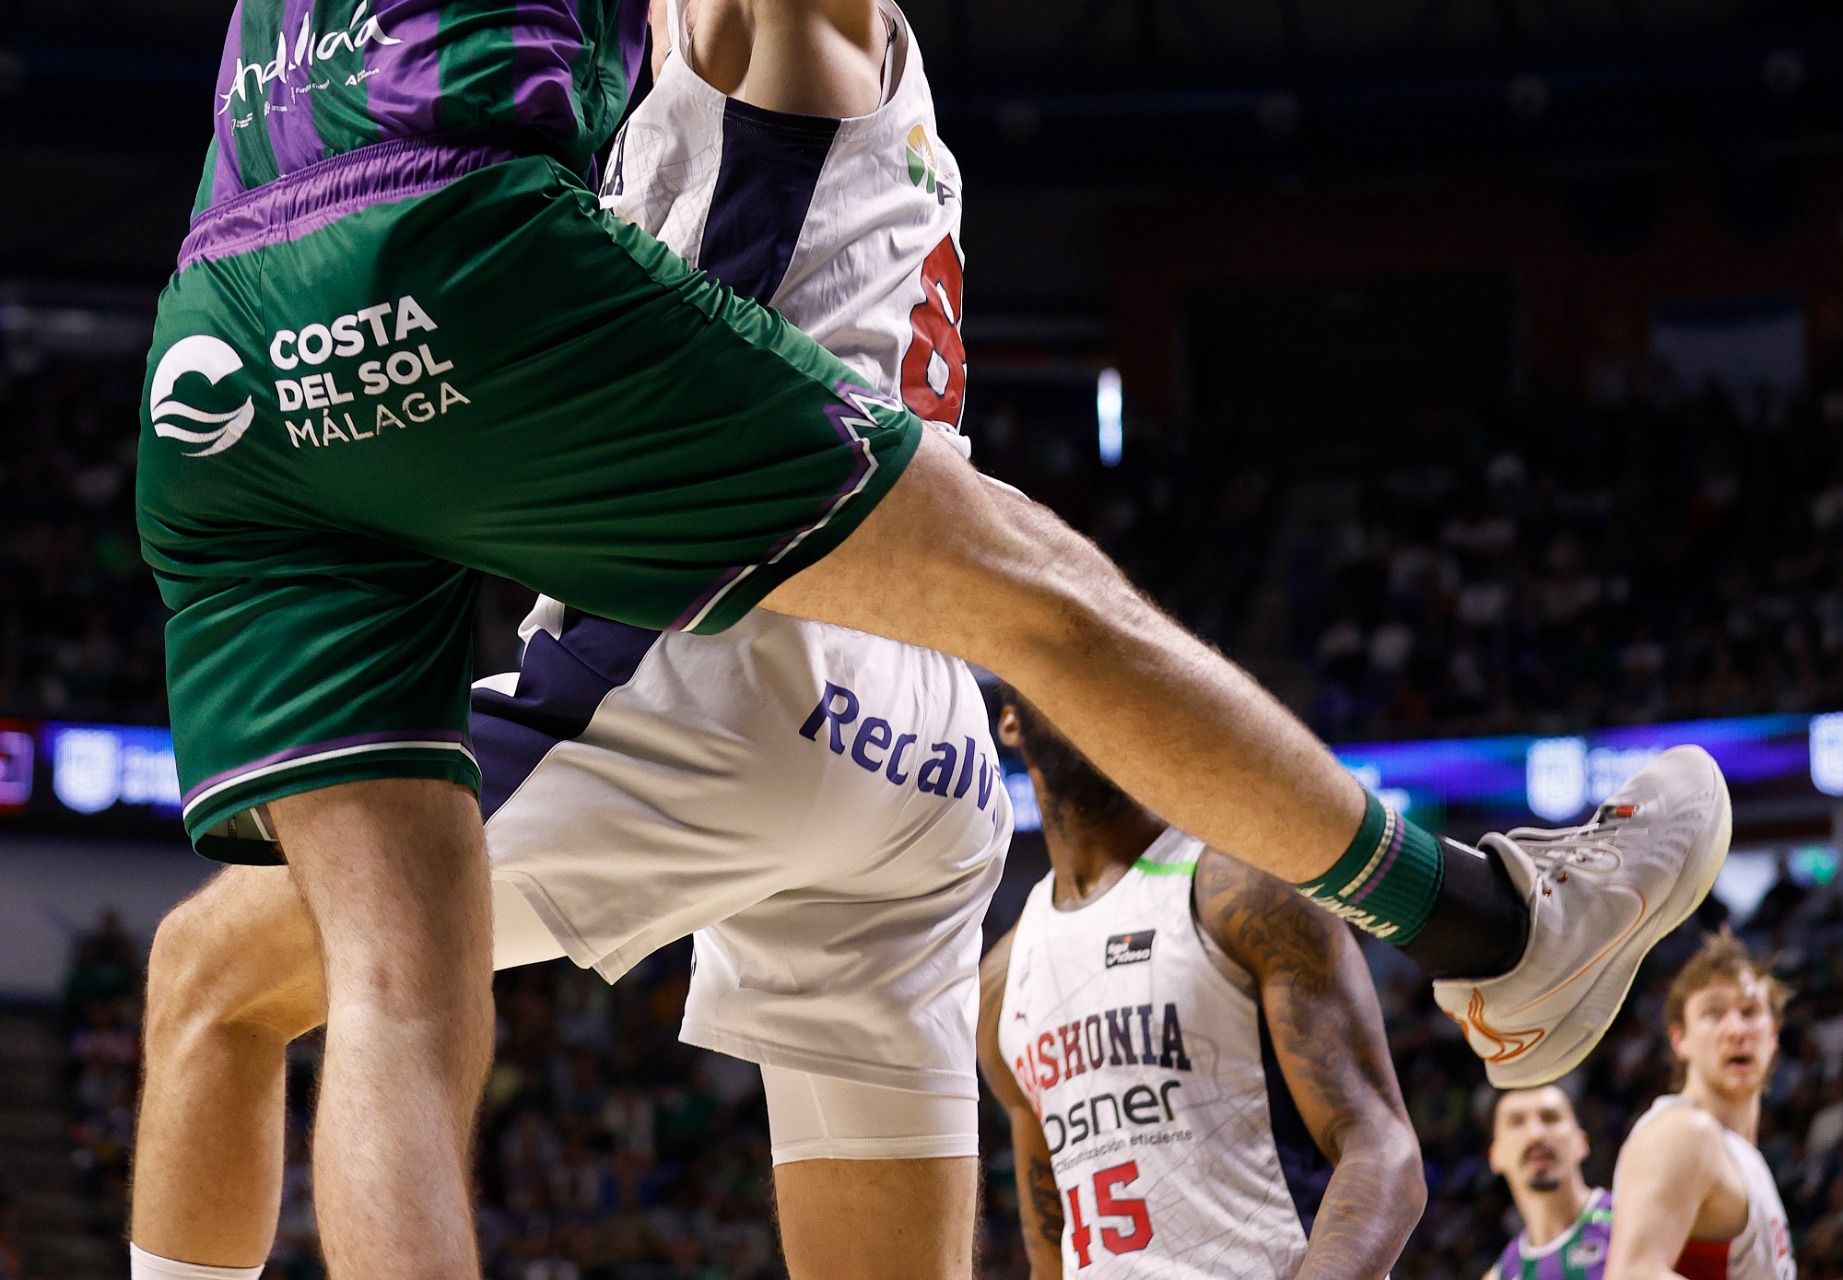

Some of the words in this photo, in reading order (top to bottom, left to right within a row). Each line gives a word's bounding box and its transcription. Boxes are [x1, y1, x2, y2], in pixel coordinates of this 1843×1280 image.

[269, 294, 439, 370] COSTA
[274, 371, 355, 412] DEL
[358, 343, 455, 396] SOL
[284, 381, 472, 449] MÁLAGA
[798, 679, 1001, 826] Recalv
[1015, 1002, 1192, 1096] SKONIA
